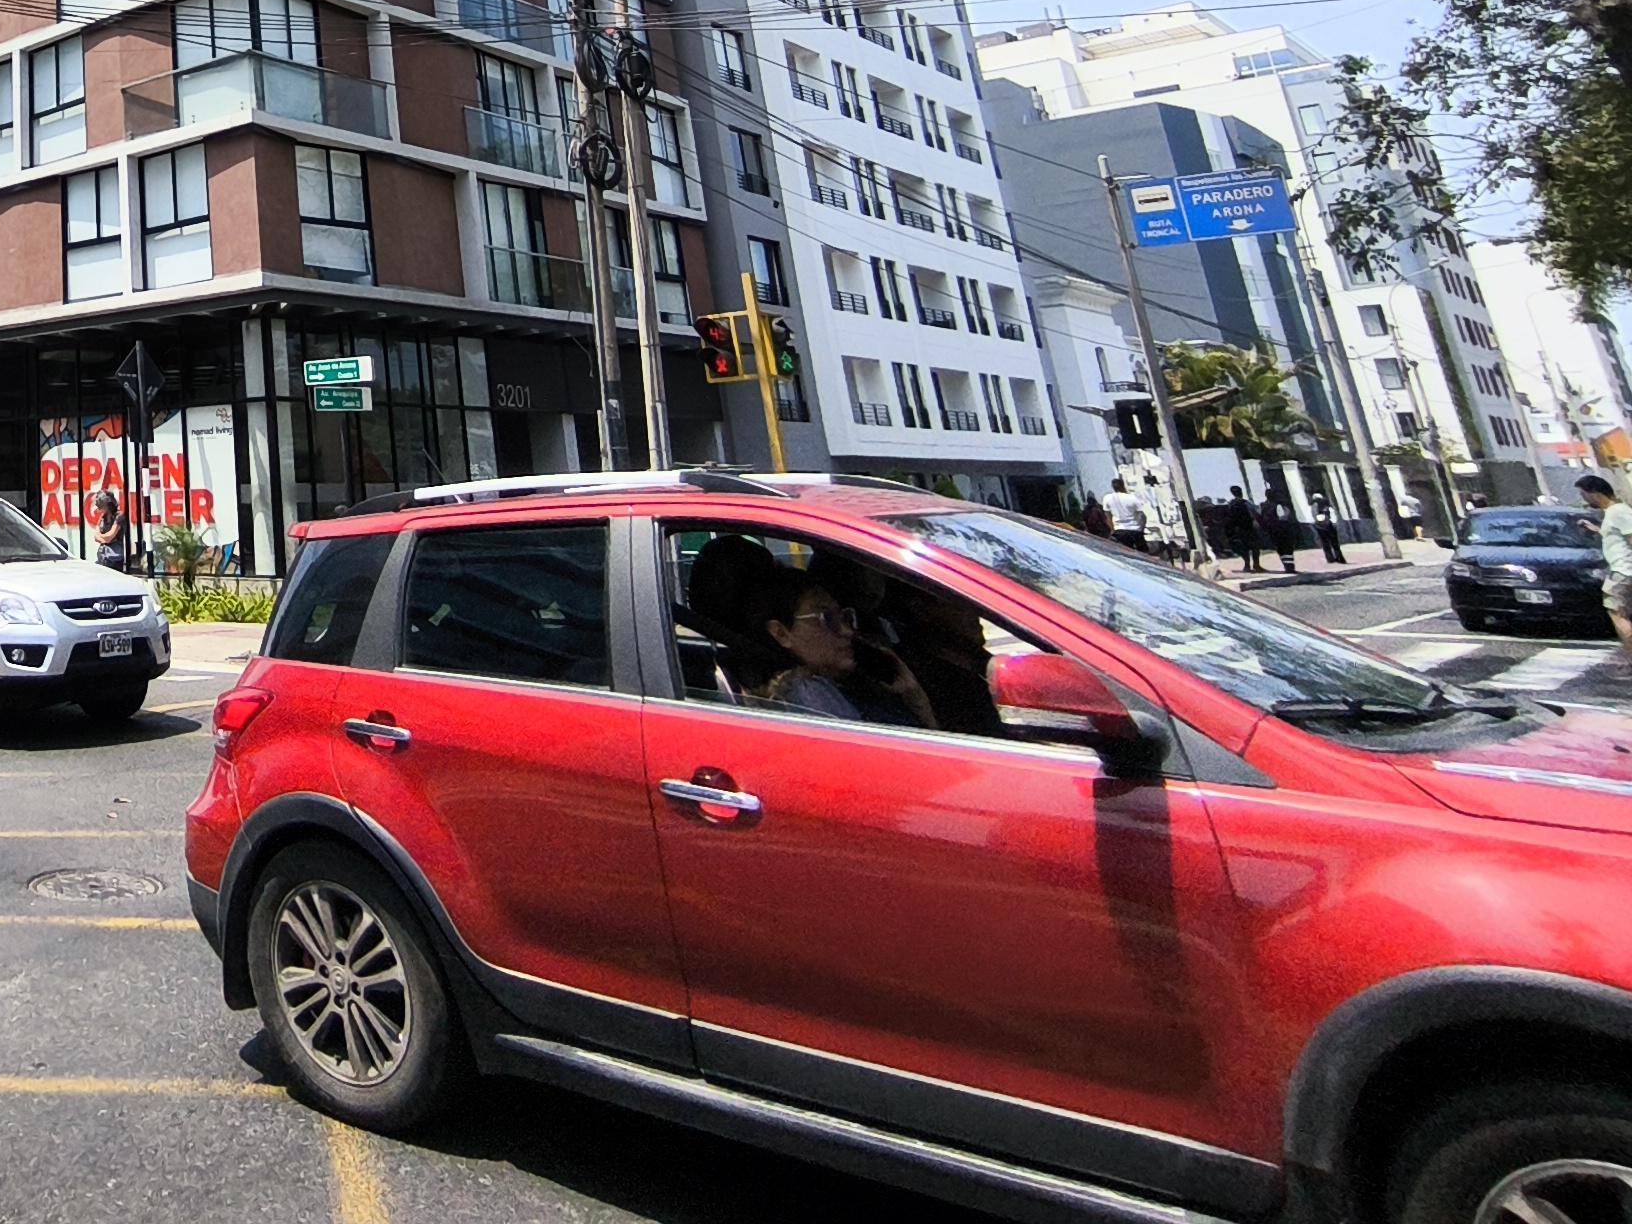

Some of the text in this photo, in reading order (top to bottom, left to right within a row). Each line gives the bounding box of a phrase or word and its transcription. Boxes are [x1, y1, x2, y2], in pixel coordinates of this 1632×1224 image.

[1191, 184, 1274, 205] PARADERO
[1212, 205, 1266, 219] ARONA
[1148, 218, 1173, 229] RUTA
[1141, 227, 1182, 239] TRONCAL
[496, 383, 531, 409] 3201
[191, 426, 233, 436] nomad living
[41, 457, 125, 493] DEPA
